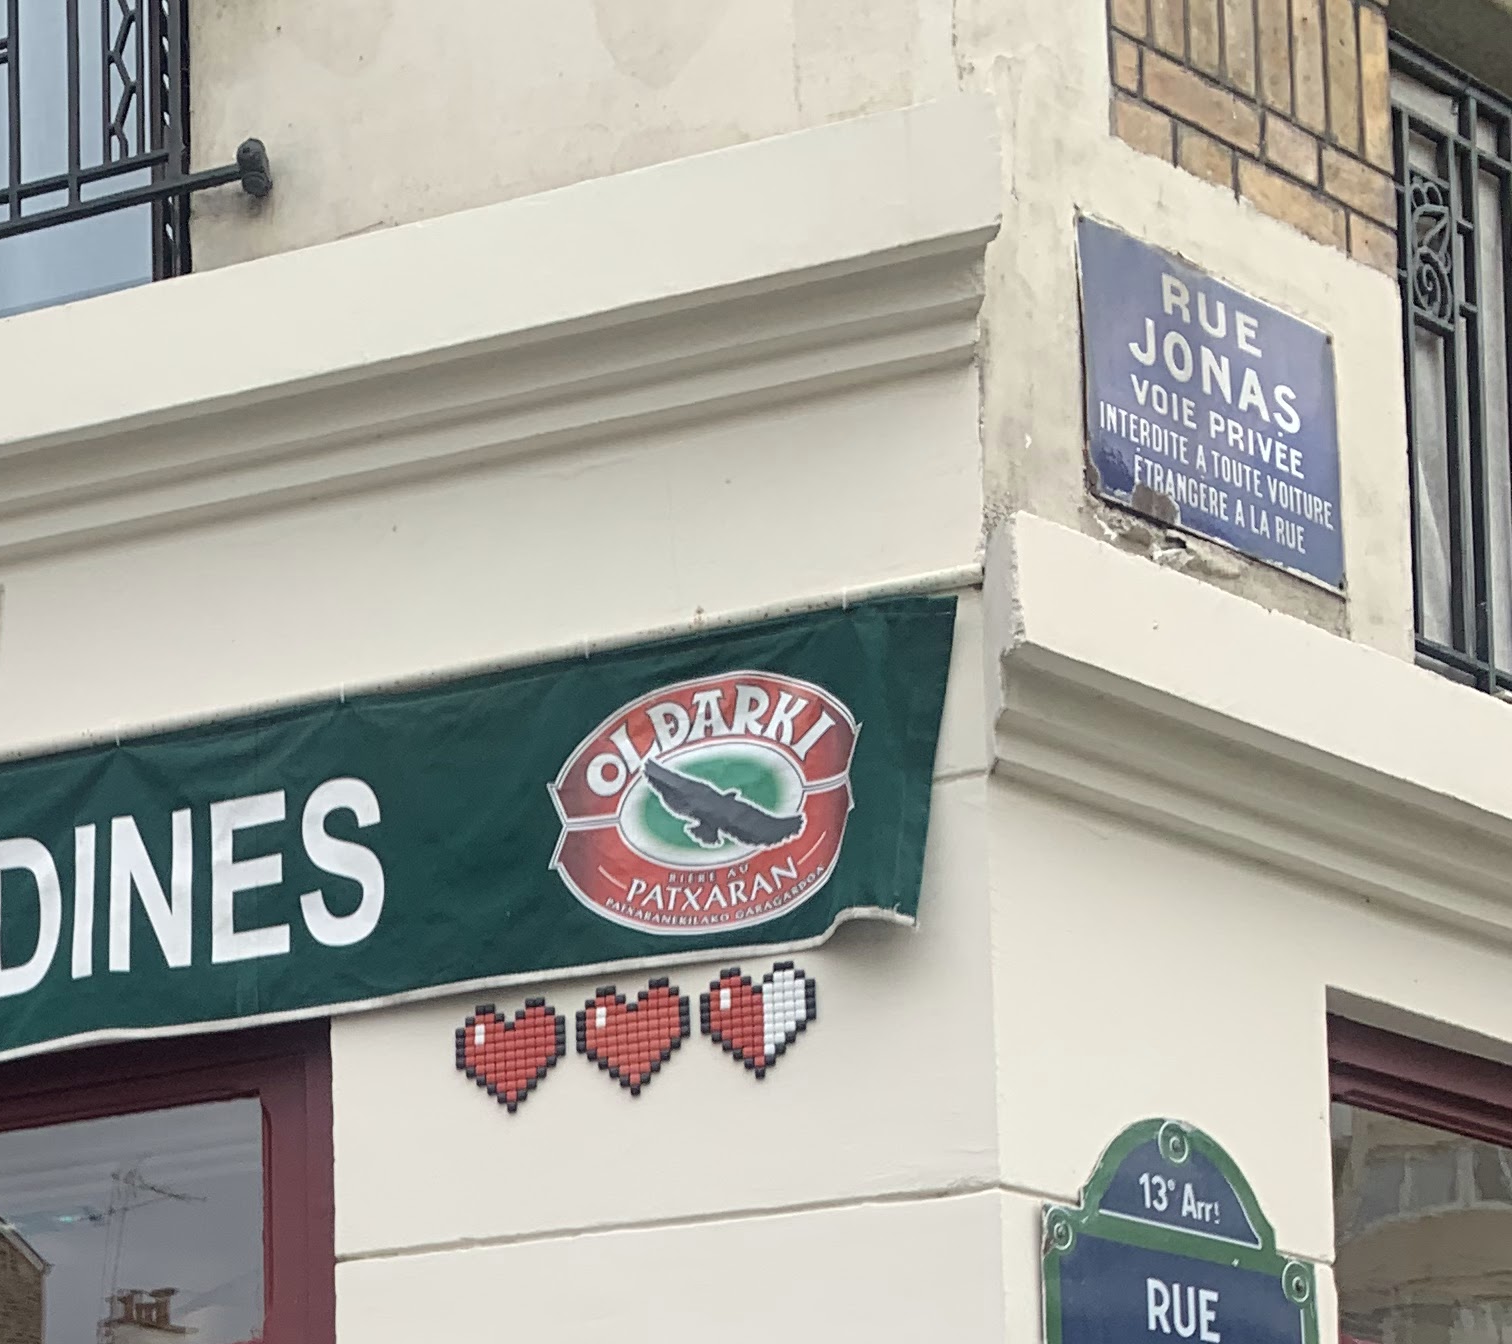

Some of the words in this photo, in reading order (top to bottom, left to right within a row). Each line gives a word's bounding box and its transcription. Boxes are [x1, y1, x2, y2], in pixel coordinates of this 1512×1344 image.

[1161, 272, 1263, 359] RUE
[1129, 317, 1302, 435] JONAS
[1099, 401, 1190, 466] INTERDITE
[1210, 449, 1264, 499] TOUTE
[1267, 475, 1335, 532] VOITURE
[1130, 373, 1198, 430] VOIE
[1208, 410, 1305, 480] PRIVÉE
[1250, 504, 1271, 540] LA
[1275, 518, 1306, 555] RUE
[587, 683, 841, 797] OLDARKI
[626, 855, 799, 912] PATXARAN
[1146, 1277, 1221, 1344] RUE
